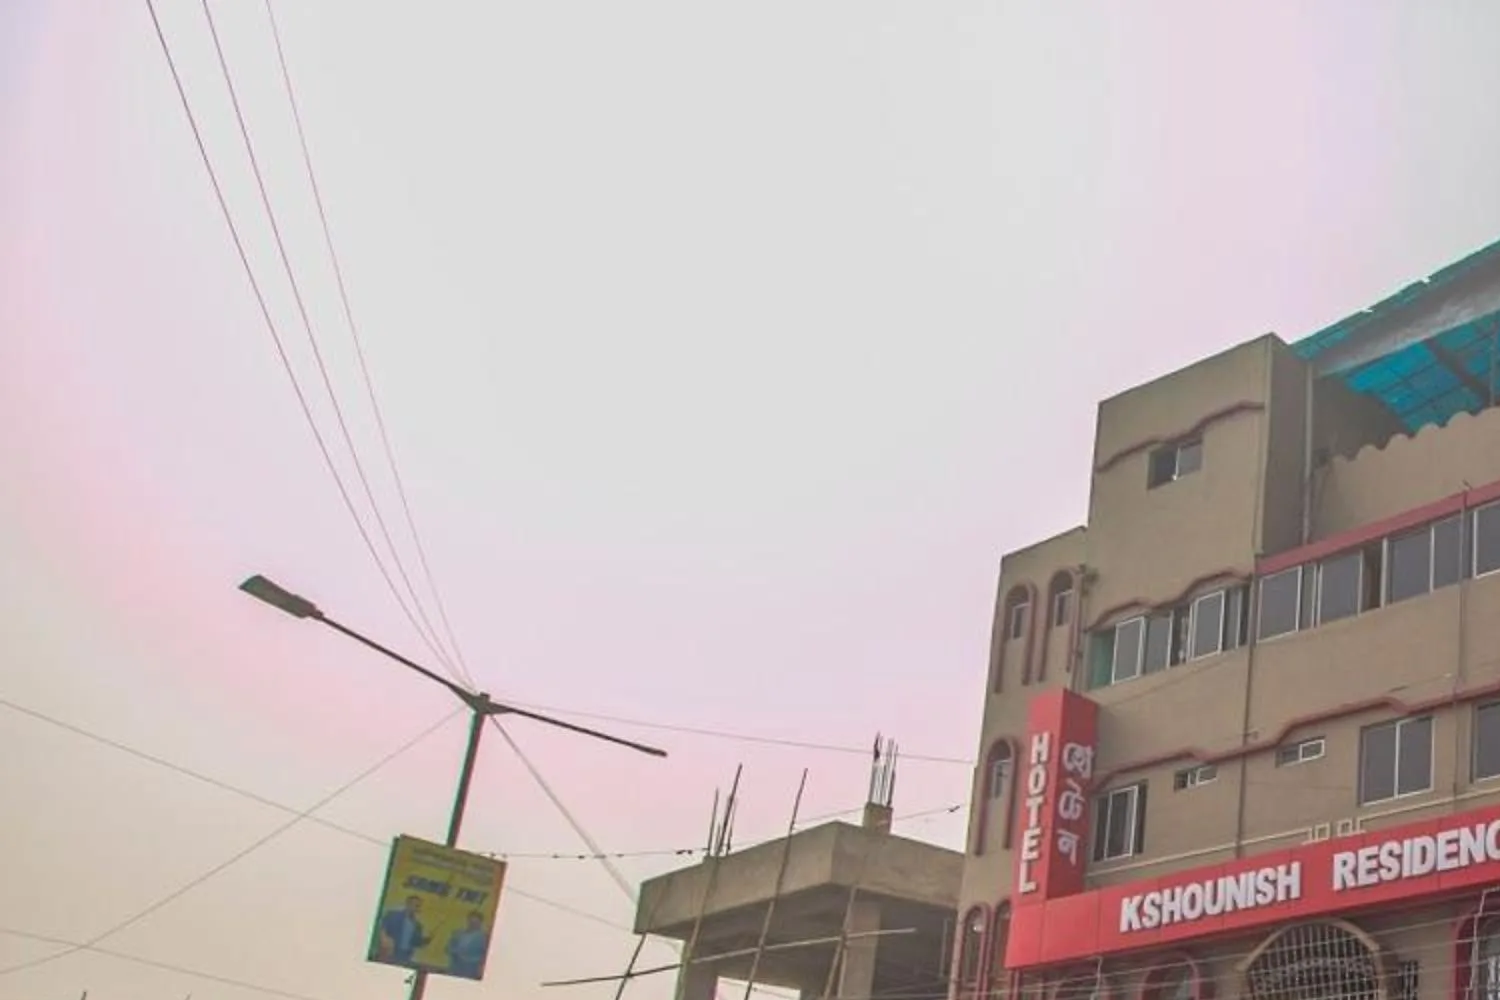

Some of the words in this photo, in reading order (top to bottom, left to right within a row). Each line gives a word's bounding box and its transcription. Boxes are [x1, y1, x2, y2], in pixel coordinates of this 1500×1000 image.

[1019, 731, 1050, 893] HOTEL
[1056, 741, 1094, 866] হোটেল
[1119, 860, 1302, 933] KSHOUNISH
